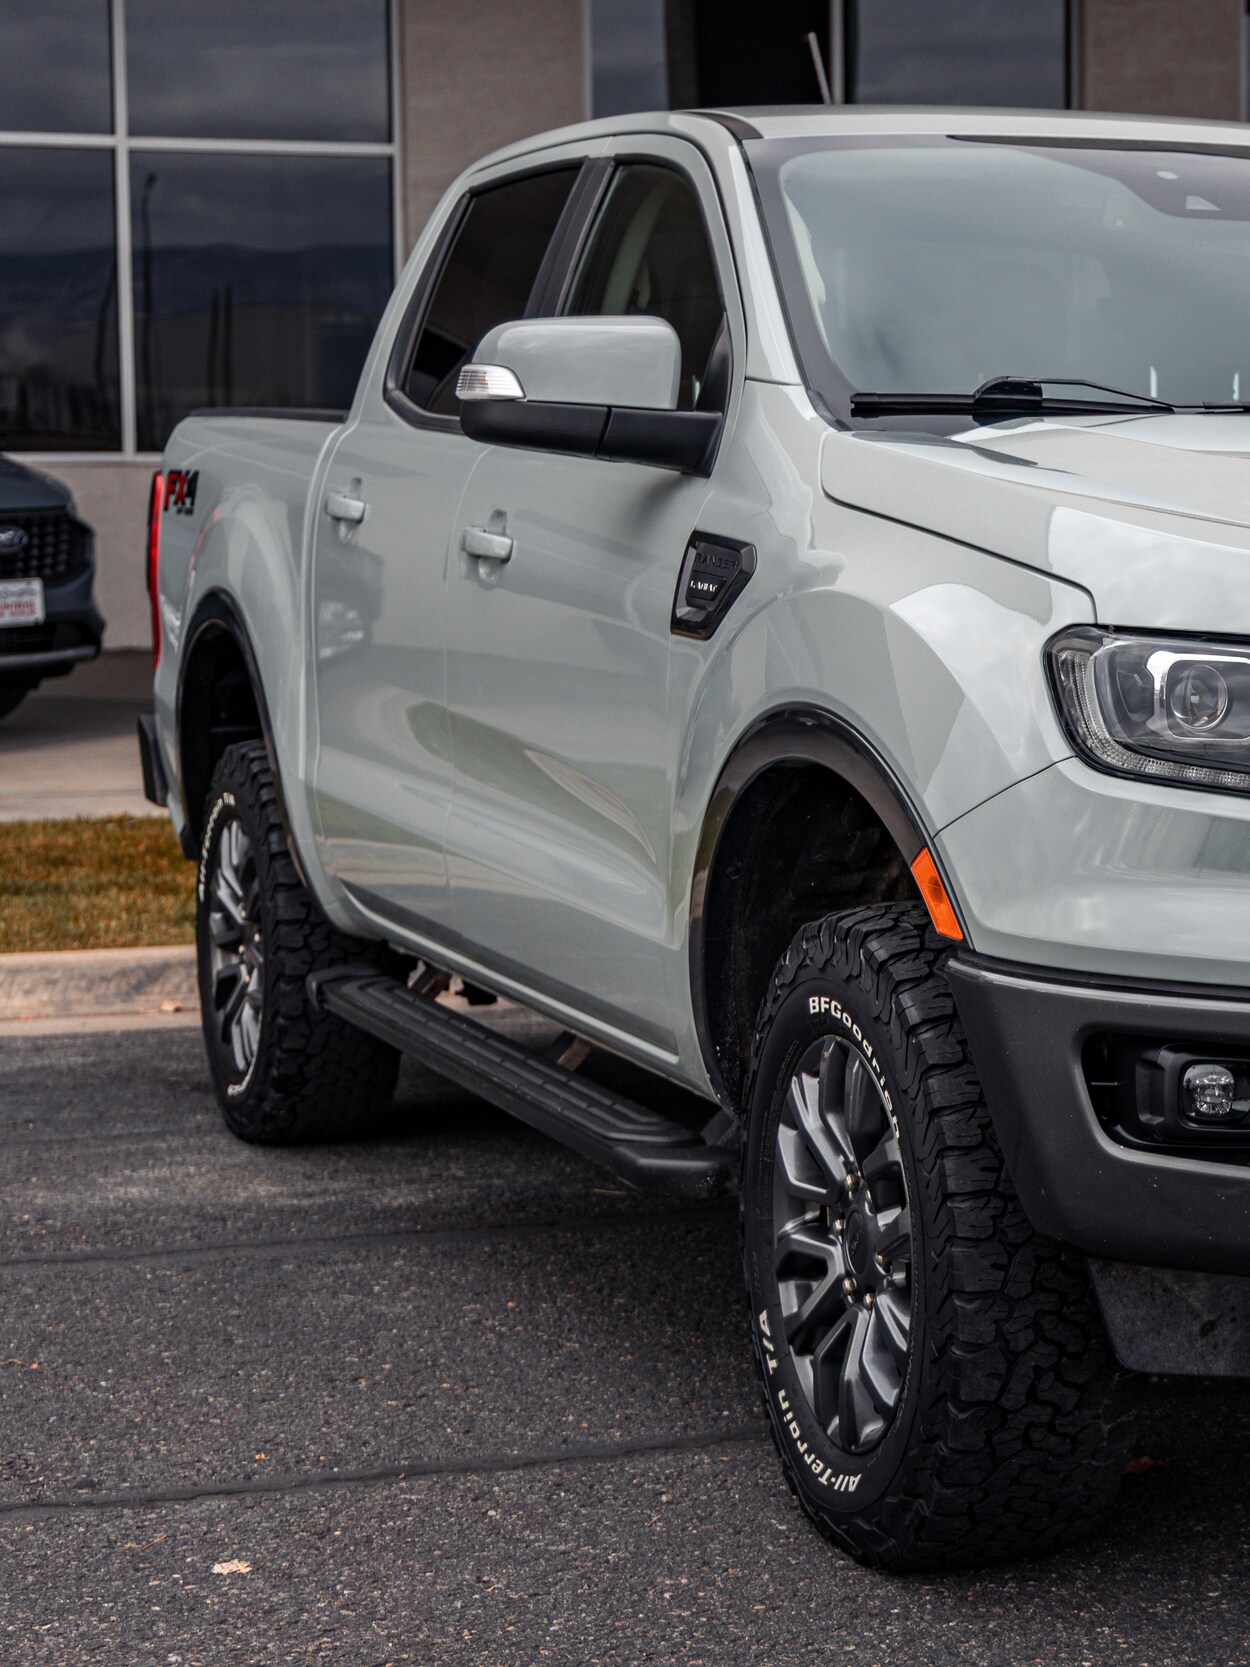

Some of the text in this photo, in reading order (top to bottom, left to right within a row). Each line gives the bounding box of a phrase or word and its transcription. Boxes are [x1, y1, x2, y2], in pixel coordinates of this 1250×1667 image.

[164, 469, 199, 511] FX4
[694, 552, 738, 571] RANGER
[808, 996, 900, 1139] BFGoodrich
[758, 1308, 862, 1493] All-Terrain T/A
